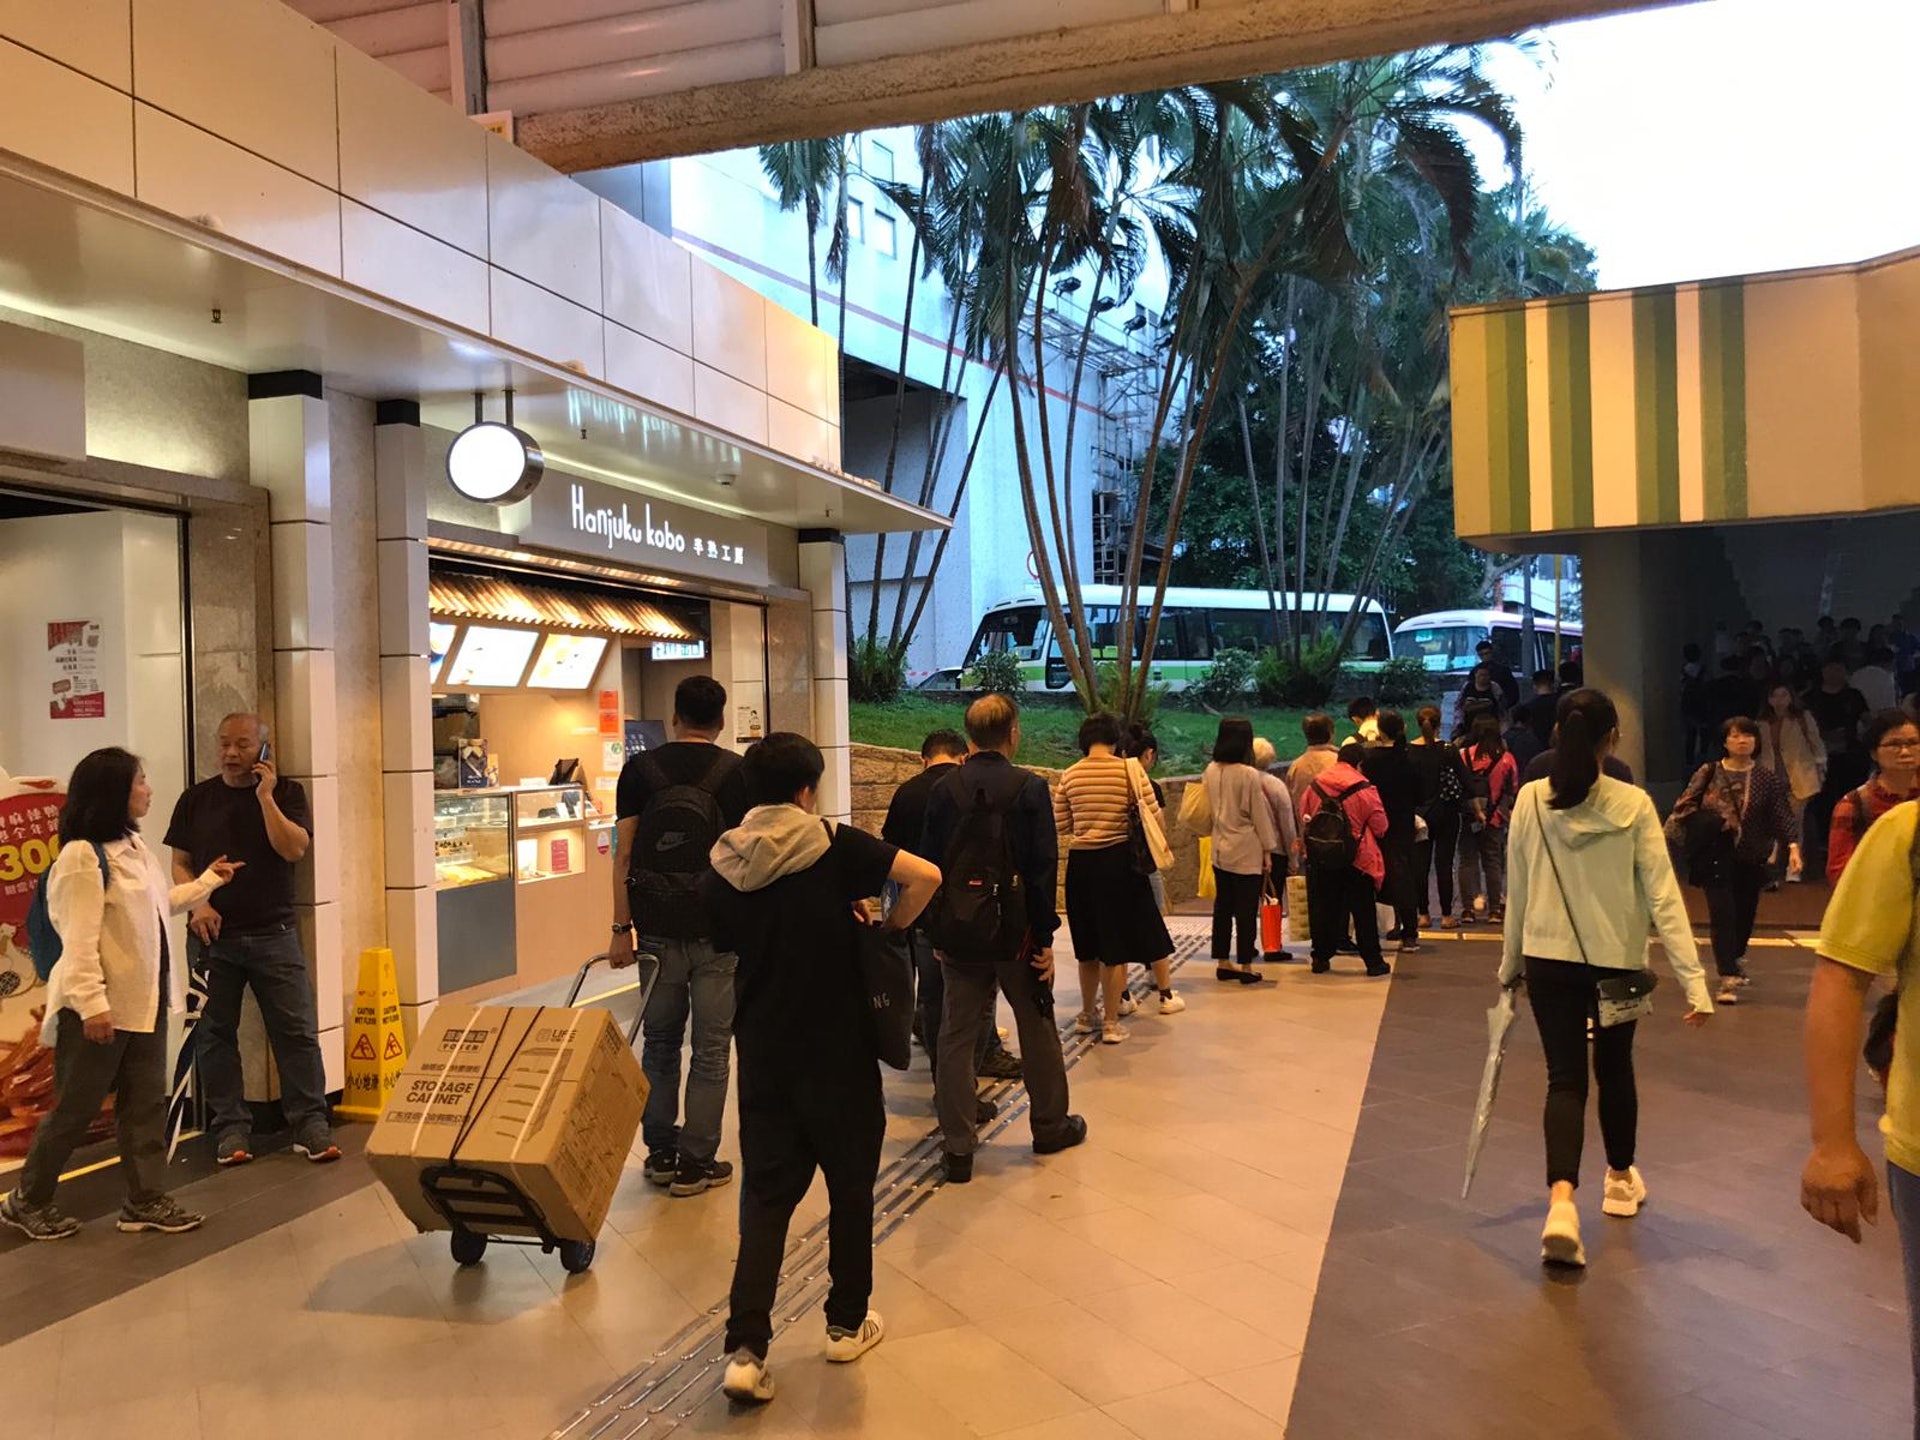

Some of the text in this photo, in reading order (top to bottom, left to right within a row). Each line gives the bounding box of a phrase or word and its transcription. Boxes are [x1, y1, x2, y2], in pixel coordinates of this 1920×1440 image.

[571, 484, 686, 552] Hanjuku kobo
[411, 1080, 474, 1094] STORAGE
[406, 1091, 463, 1105] CAINET
